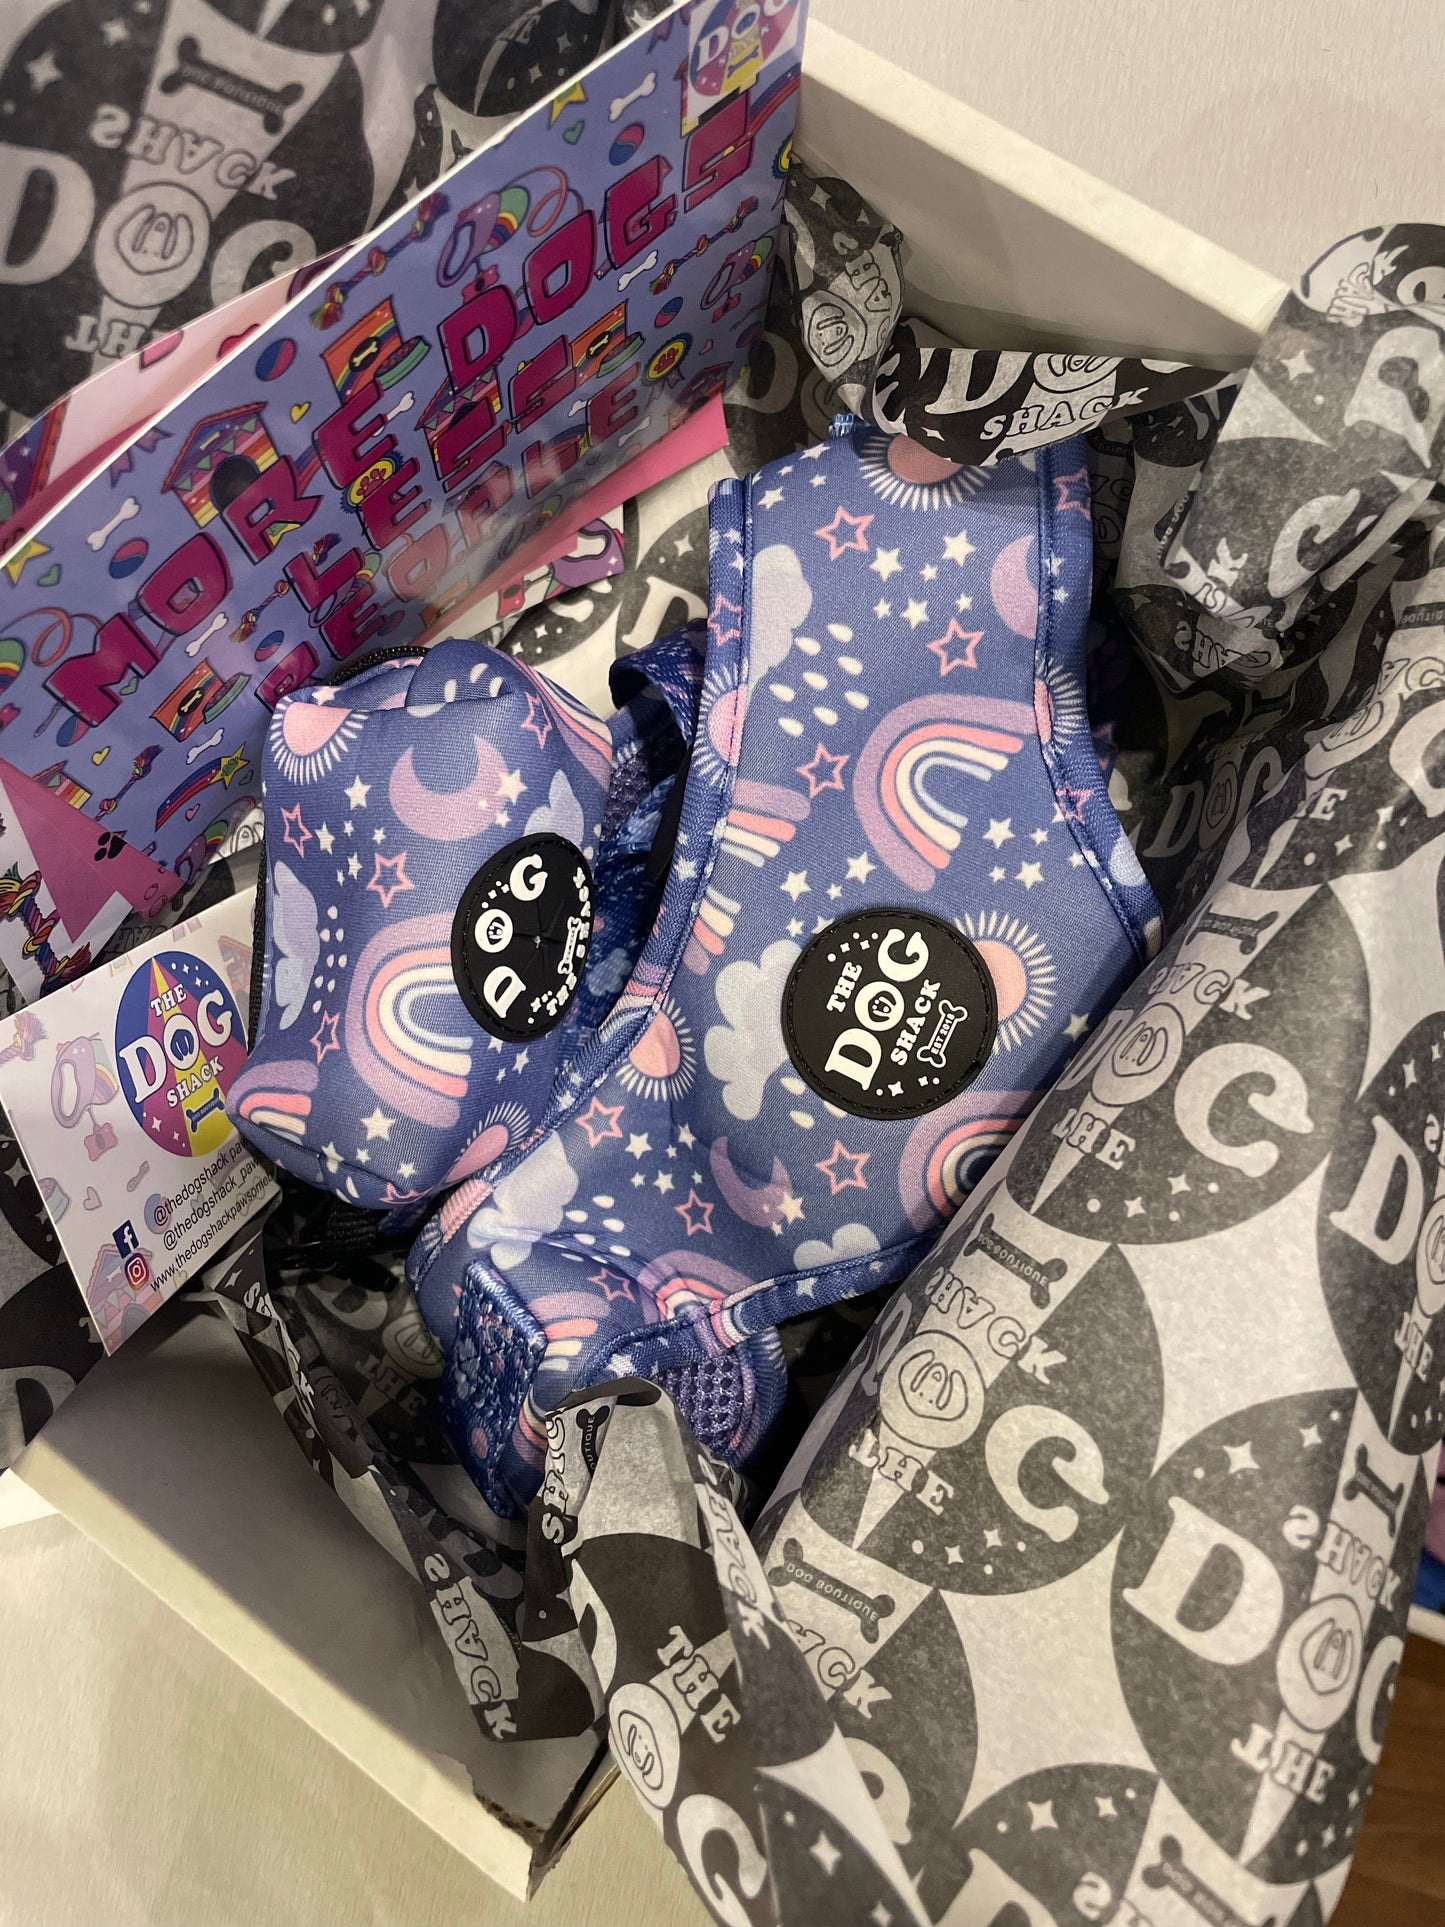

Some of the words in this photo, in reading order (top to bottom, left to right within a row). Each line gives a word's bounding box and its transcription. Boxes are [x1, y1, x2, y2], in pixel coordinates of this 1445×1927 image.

[43, 379, 400, 727] MORE
[437, 88, 757, 395] DOGS
[980, 386, 1149, 441] SHACK
[283, 335, 576, 613] LESS
[475, 853, 549, 1019] DOG
[150, 984, 188, 1016] THE
[824, 928, 929, 1091] DOG
[826, 961, 863, 1013] THE
[890, 979, 942, 1067] SHACK
[119, 989, 234, 1104] DOG
[166, 1055, 224, 1109] SHACK
[930, 1034, 946, 1055] EST
[152, 1151, 231, 1227] @thedogshack
[584, 1415, 597, 1470] OUTIQUE
[656, 1624, 742, 1744] THE
